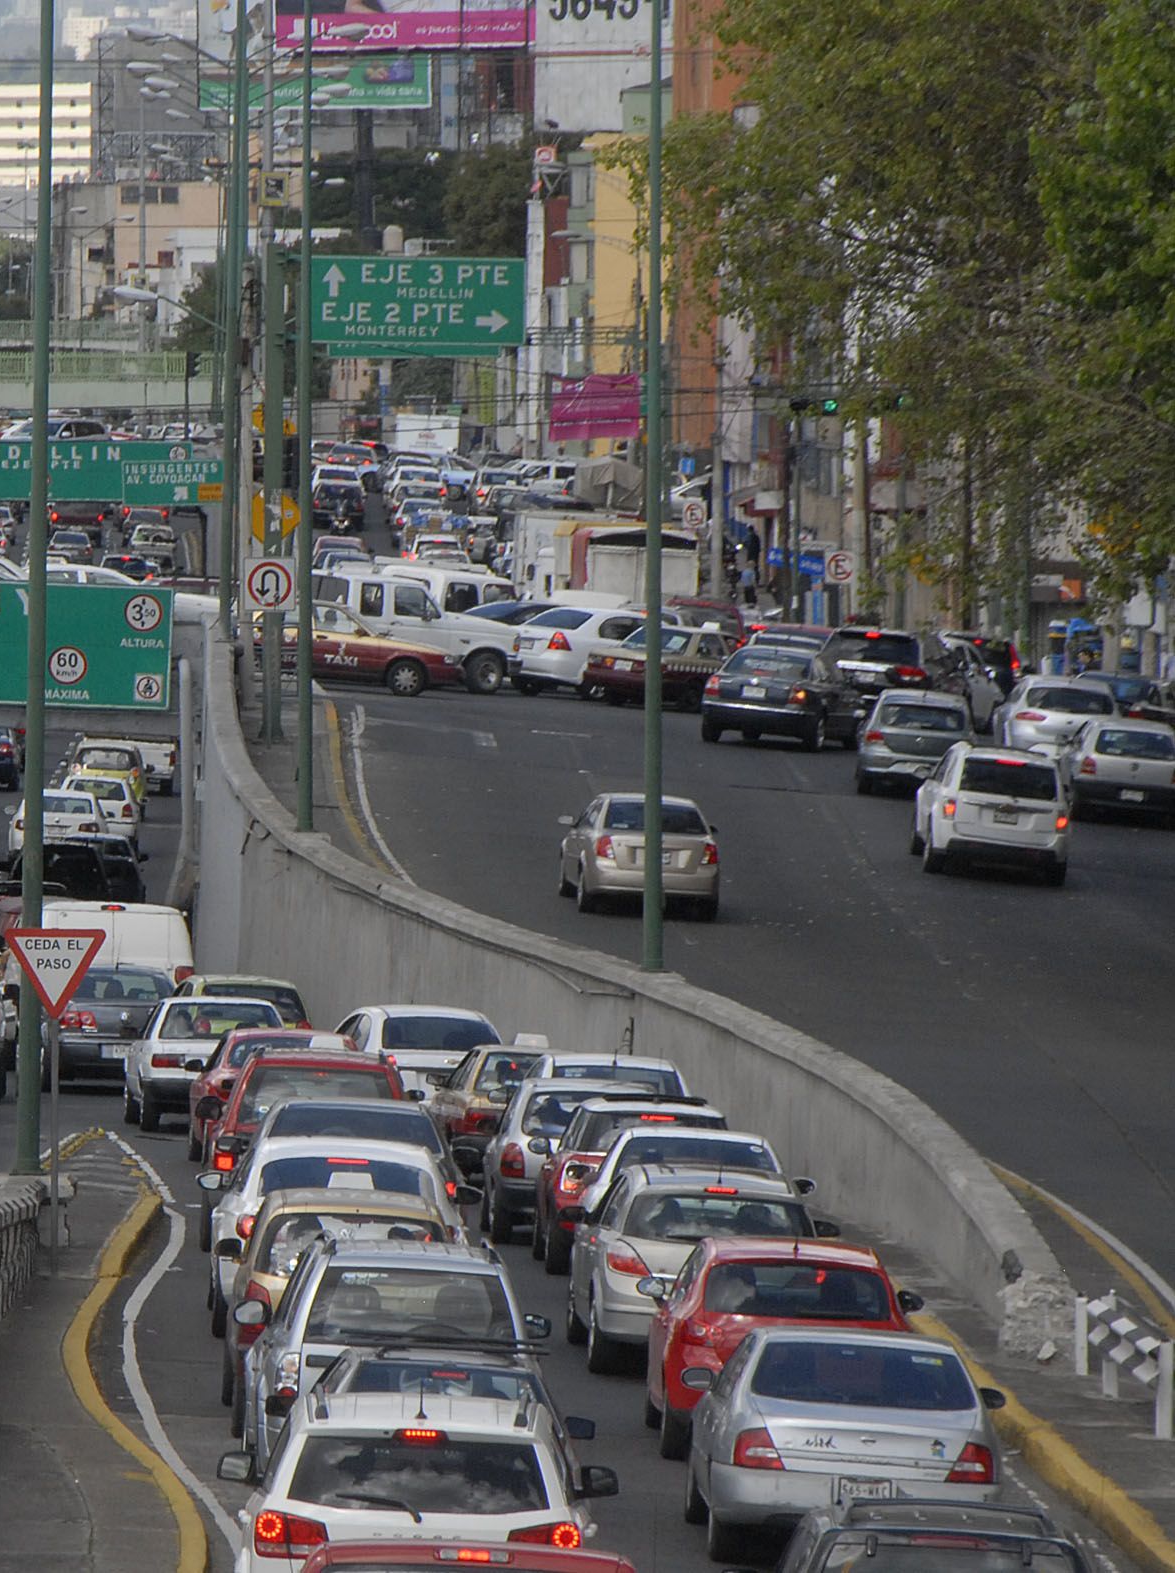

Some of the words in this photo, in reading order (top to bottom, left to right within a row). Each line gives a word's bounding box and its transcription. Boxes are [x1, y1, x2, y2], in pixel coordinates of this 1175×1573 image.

[361, 264, 413, 284] EJE
[428, 264, 444, 285] 3
[457, 265, 509, 286] PTE
[396, 287, 474, 299] MEDELLIN
[321, 302, 372, 322] EJE
[384, 303, 401, 323] 2
[413, 303, 465, 324] PTE
[345, 325, 439, 337] MONTERREY
[125, 462, 219, 474] INSURGENTES
[127, 475, 143, 485] AV.
[149, 474, 206, 485] COYOACAN
[120, 638, 164, 649] ALTURA
[57, 652, 78, 668] 60
[324, 654, 359, 666] TAXI
[56, 669, 78, 678] km/h
[25, 939, 60, 950] CEDA
[67, 939, 83, 950] EL
[37, 958, 72, 970] PASO
